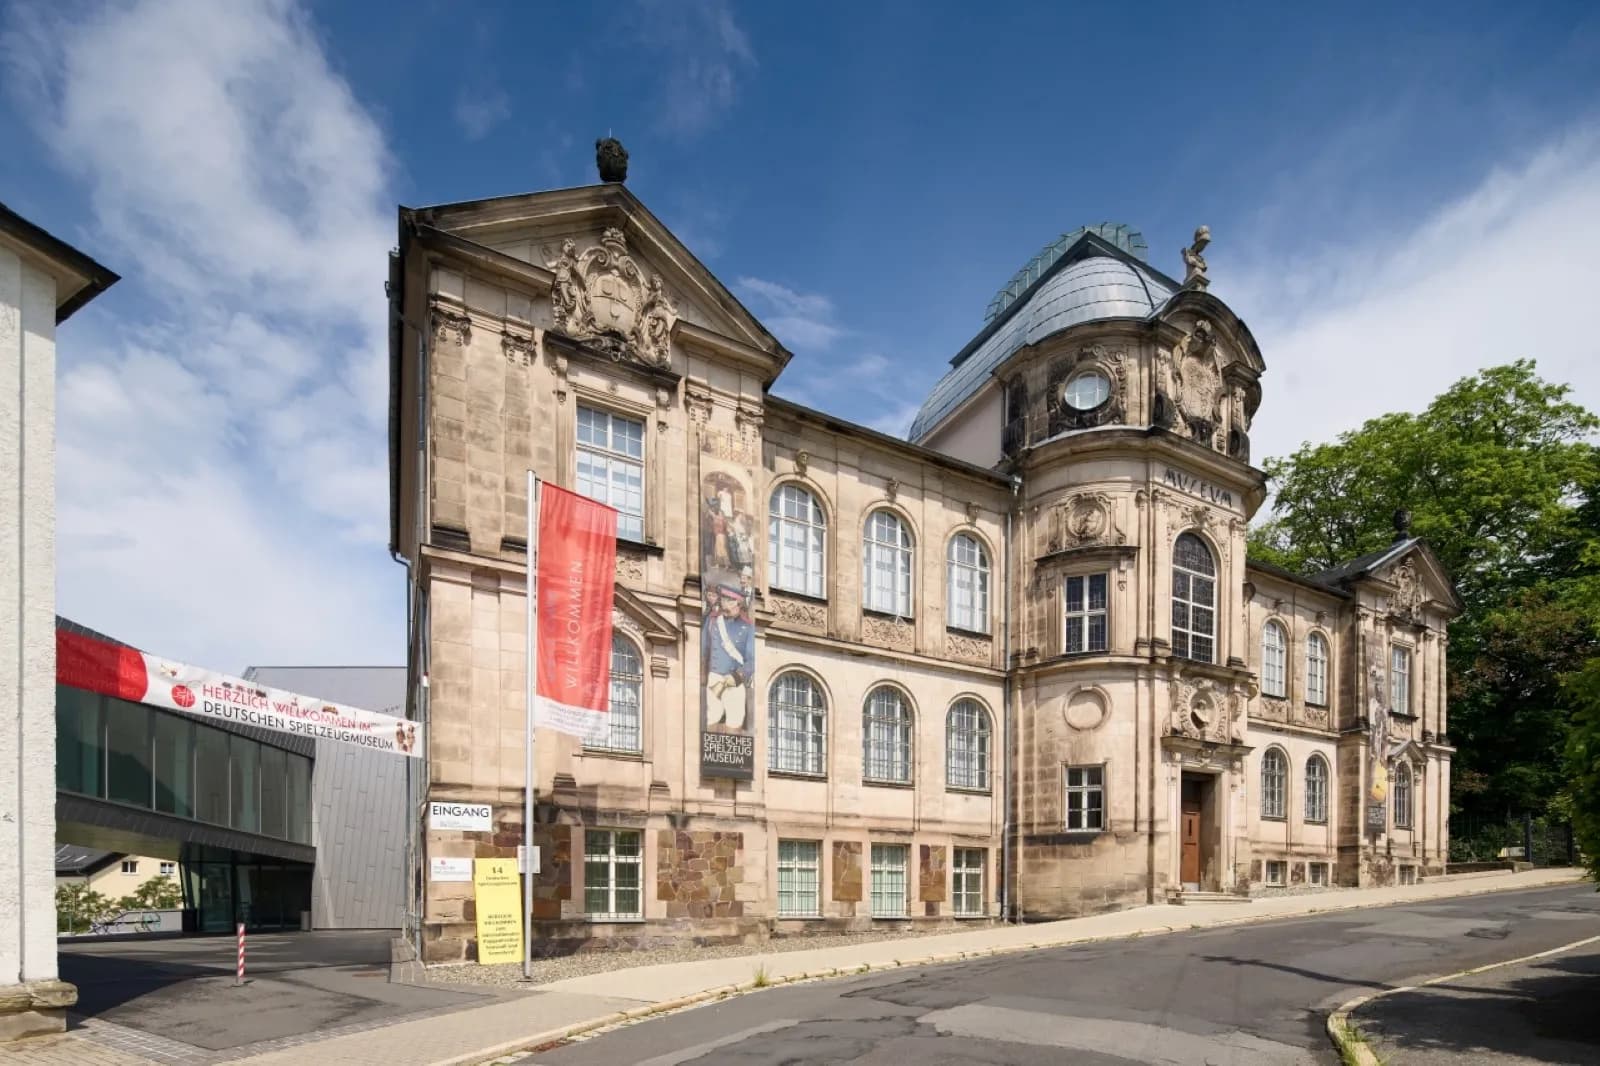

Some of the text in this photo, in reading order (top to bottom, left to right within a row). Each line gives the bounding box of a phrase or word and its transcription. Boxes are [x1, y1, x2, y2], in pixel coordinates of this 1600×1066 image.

[565, 559, 584, 689] WILLKOMMEN
[202, 684, 372, 732] HERZLICH WILLKOMMEN IM
[204, 700, 394, 750] DEUTSCHEN SPIELZEUGMUSEUM
[704, 733, 753, 747] DEUTSCHES
[704, 743, 753, 757] SPIELZEUG
[703, 752, 745, 764] MUSEUM
[432, 805, 489, 818] EINGANG
